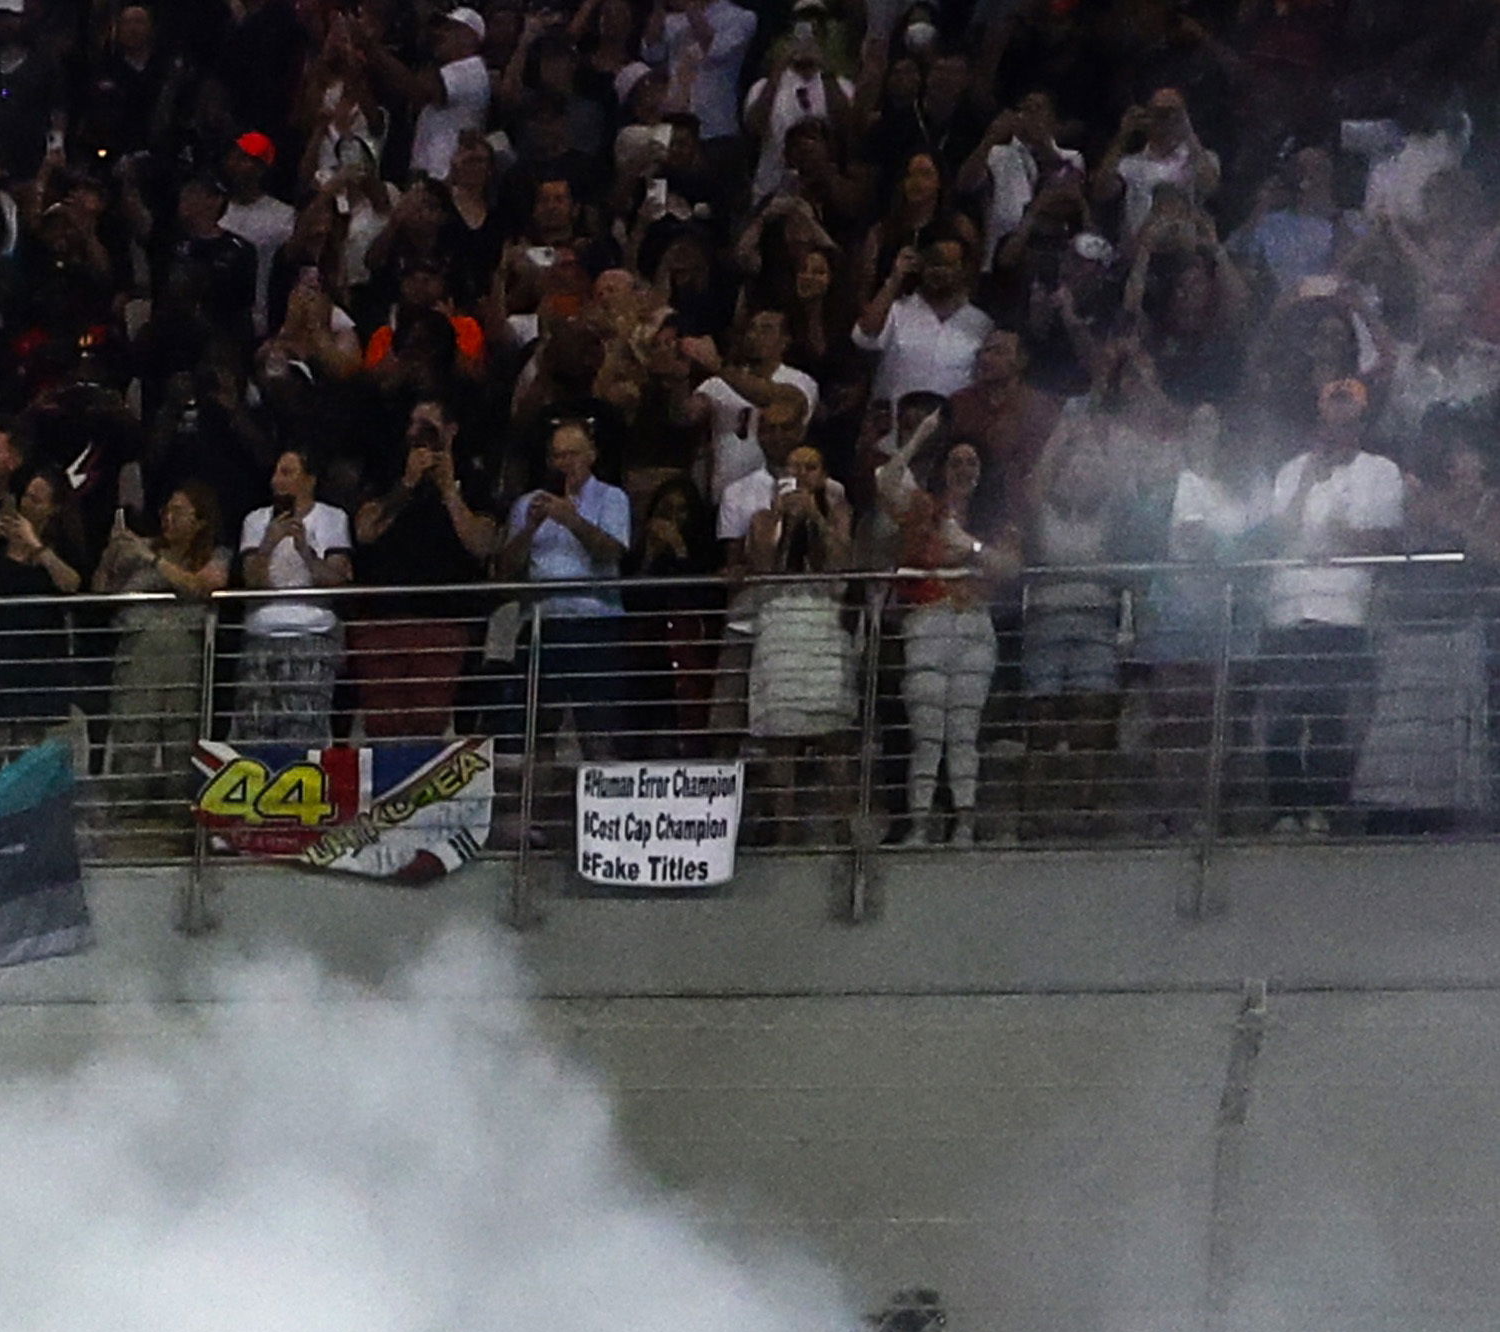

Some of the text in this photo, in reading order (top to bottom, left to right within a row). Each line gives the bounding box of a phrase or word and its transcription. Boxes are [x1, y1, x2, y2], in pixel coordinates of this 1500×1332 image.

[199, 757, 334, 826] 44
[584, 767, 737, 804] #Human Error Champion
[624, 812, 652, 849] Cap
[656, 811, 728, 846] Champion
[582, 850, 709, 882] #Fake Titles
